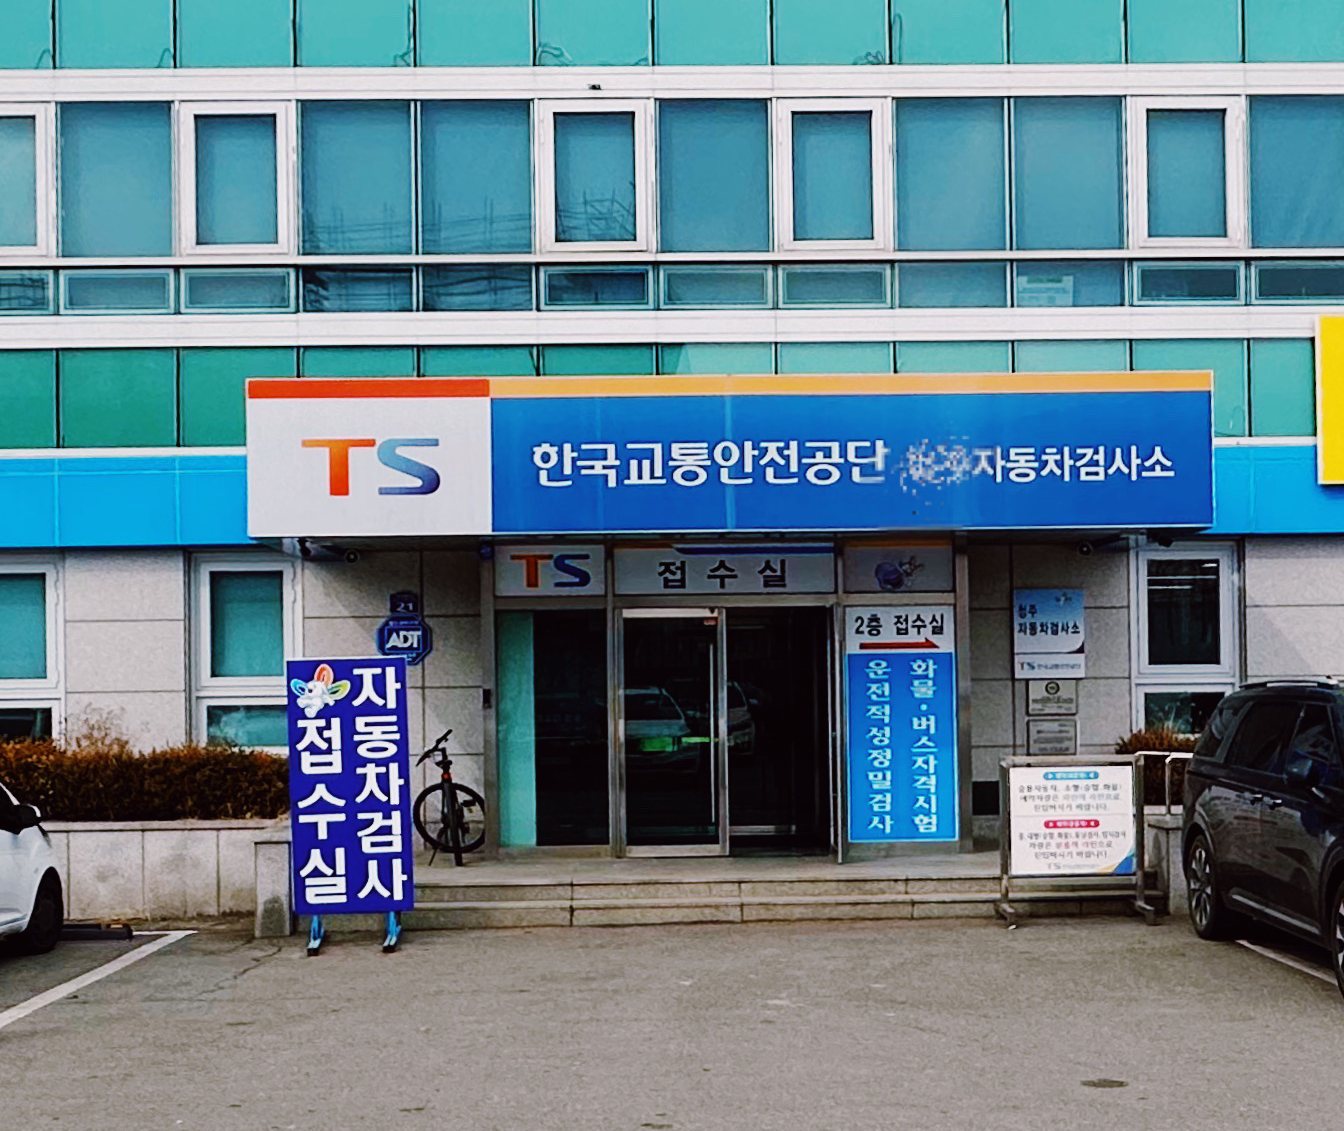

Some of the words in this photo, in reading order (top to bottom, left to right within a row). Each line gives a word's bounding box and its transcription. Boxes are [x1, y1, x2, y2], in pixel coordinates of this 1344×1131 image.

[301, 438, 441, 497] TS
[532, 439, 890, 488] 한국교통안전공단
[510, 553, 592, 589] TS
[385, 630, 422, 648] ADT
[854, 613, 883, 637] 2층
[893, 612, 946, 637] 접수실
[1017, 621, 1081, 636] 자동차검사소
[864, 659, 895, 835] 운전적성정밀검사
[351, 665, 408, 902] 자동차검사
[295, 717, 348, 905] 접수실
